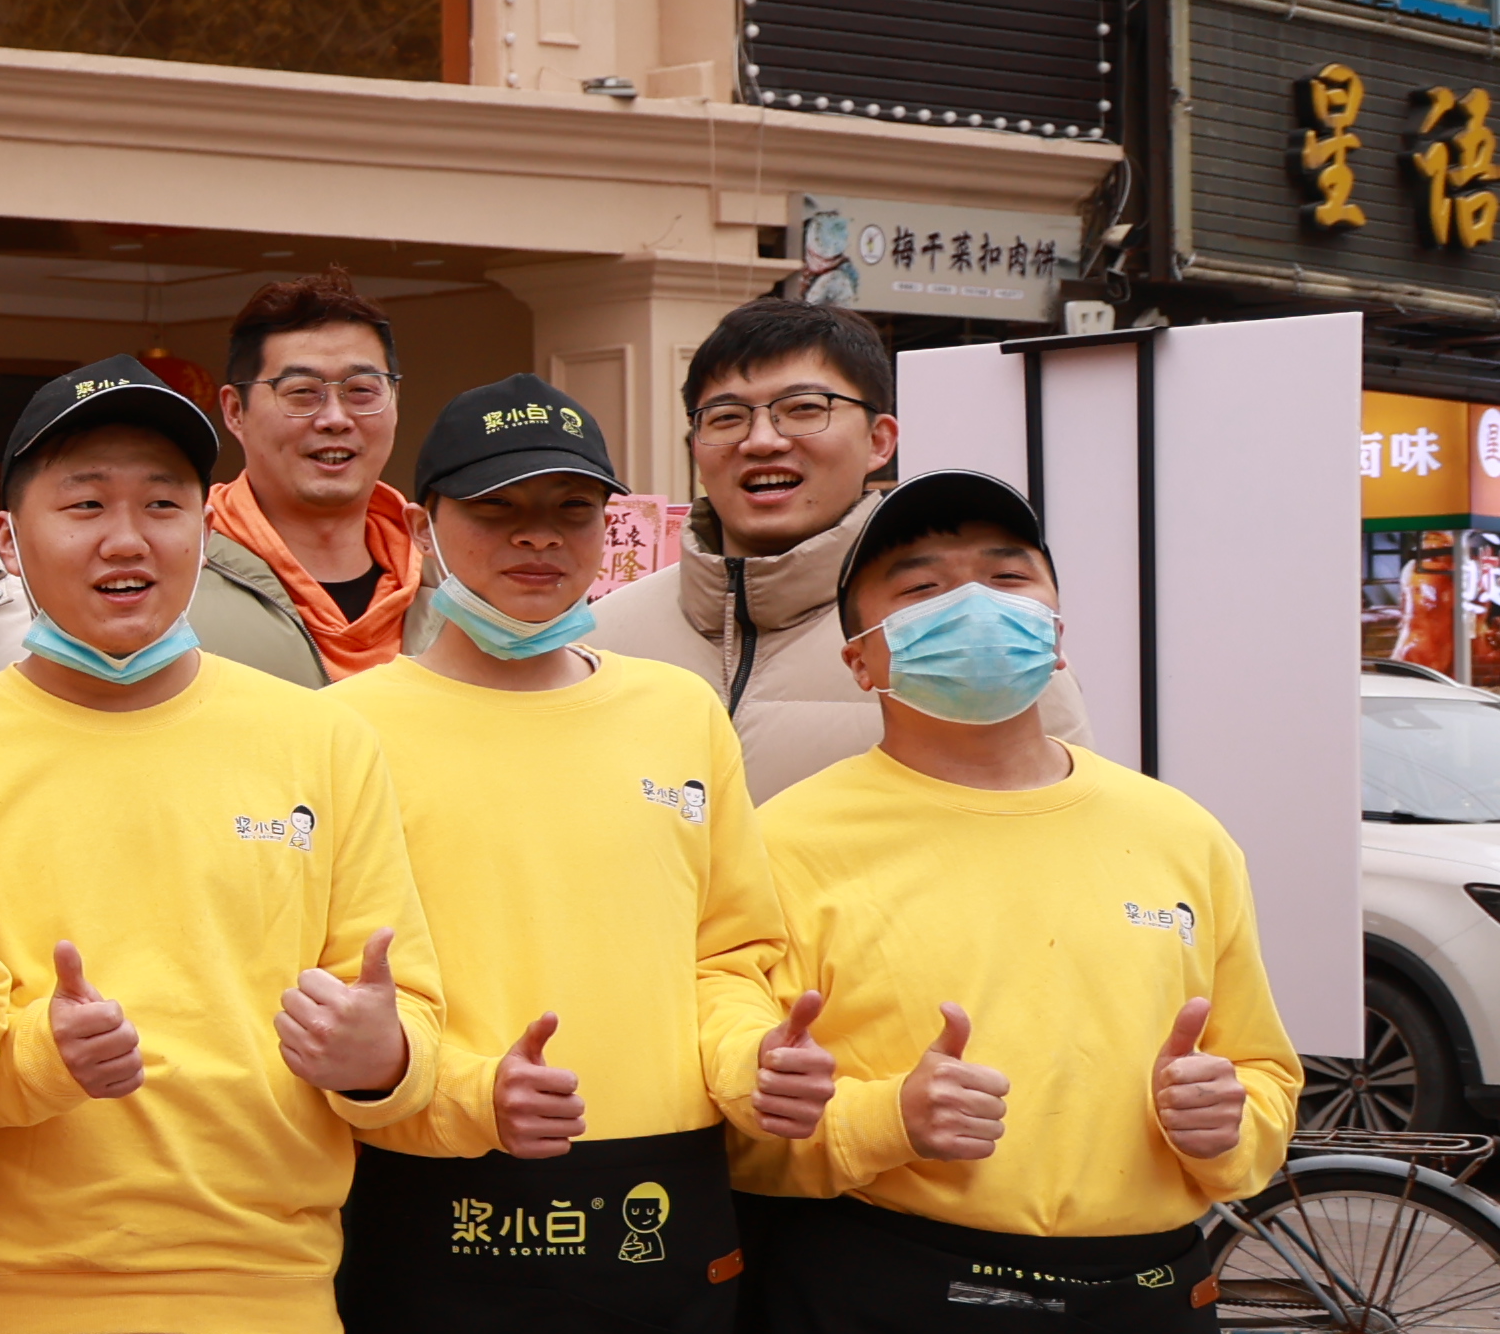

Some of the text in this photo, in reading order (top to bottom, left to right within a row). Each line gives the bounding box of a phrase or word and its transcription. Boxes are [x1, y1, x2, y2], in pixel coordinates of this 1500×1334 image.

[1303, 63, 1500, 250] 星语
[75, 378, 131, 396] 浆小
[482, 403, 548, 430] 浆小白
[451, 1198, 587, 1244] 浆小白
[451, 1245, 587, 1257] BAI'S SOYMILK
